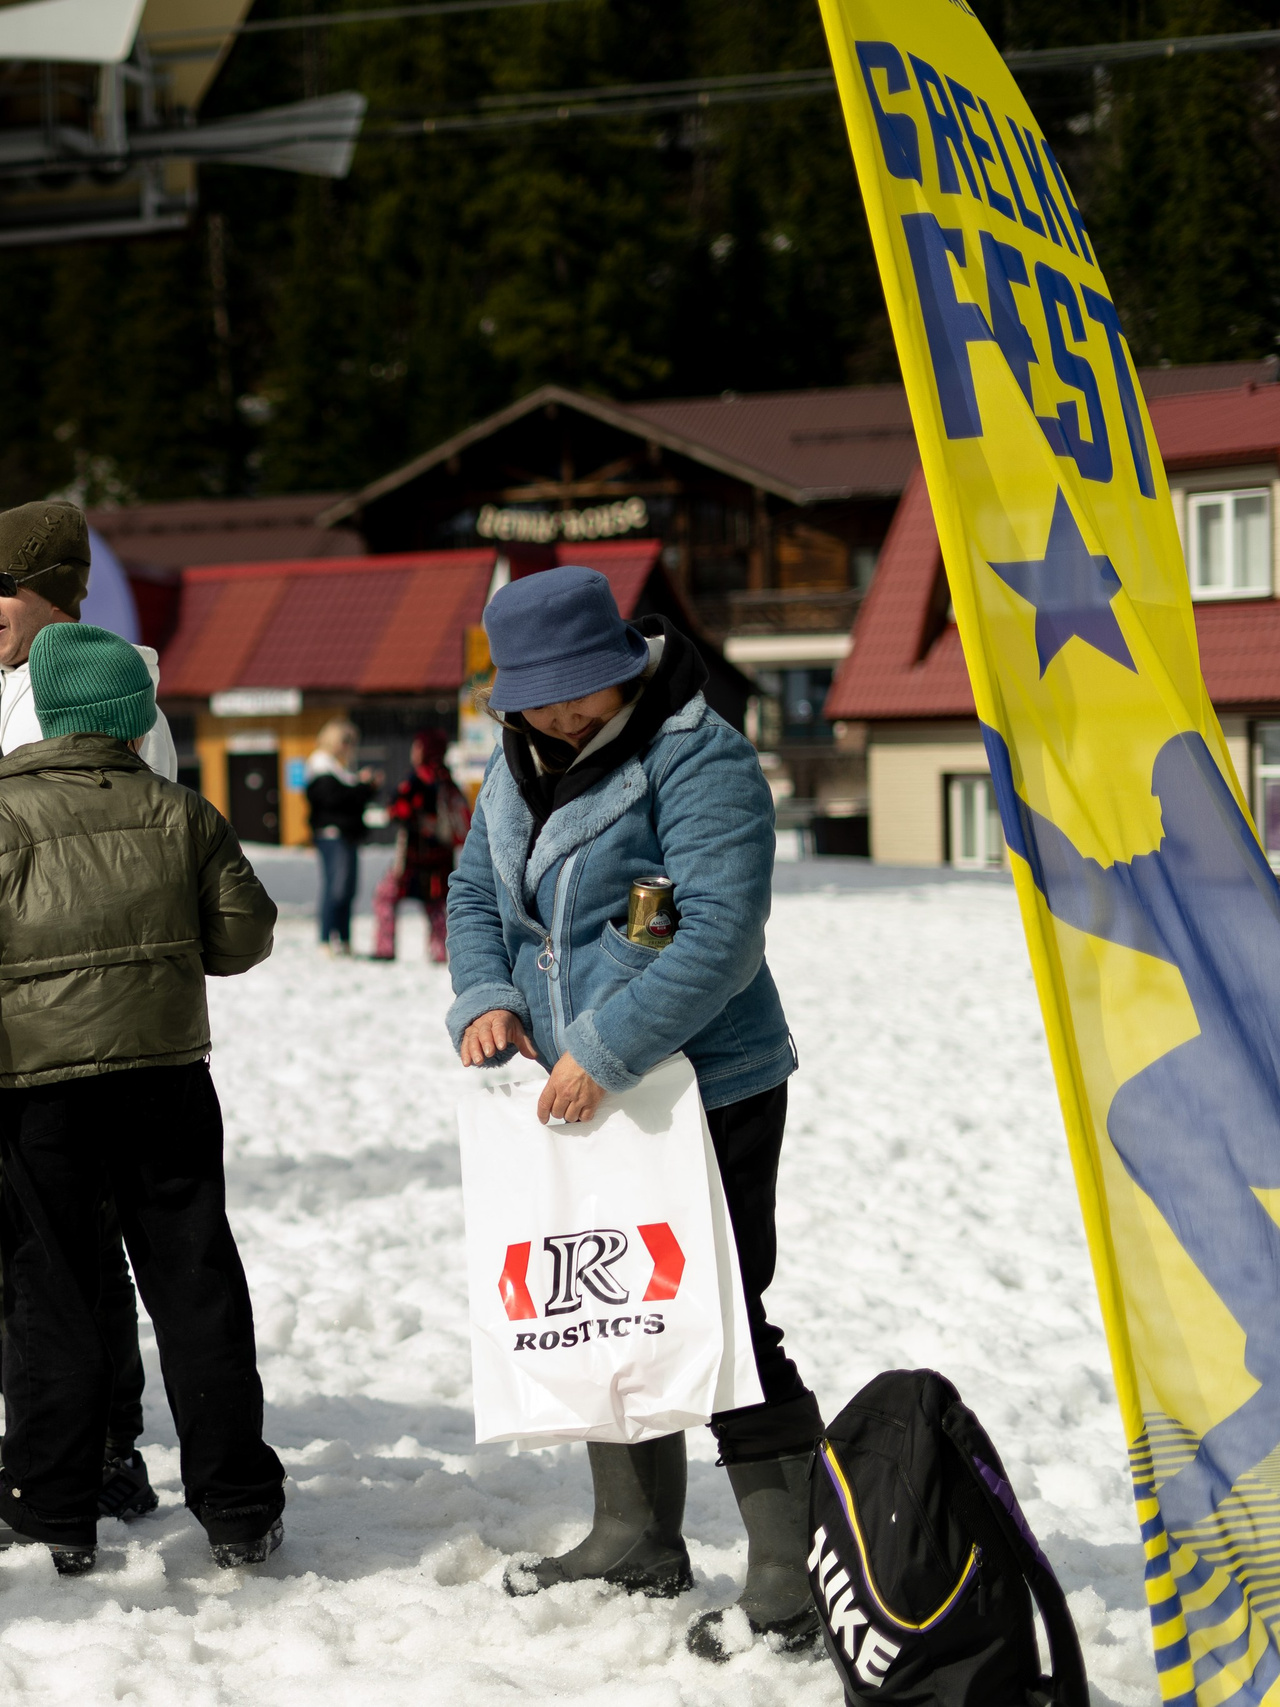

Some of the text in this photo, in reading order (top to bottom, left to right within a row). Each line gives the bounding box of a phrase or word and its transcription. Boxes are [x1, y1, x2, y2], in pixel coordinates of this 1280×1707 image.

[901, 211, 1157, 500] FEST
[544, 1229, 630, 1317] R
[514, 1313, 666, 1351] ROSTIC'S
